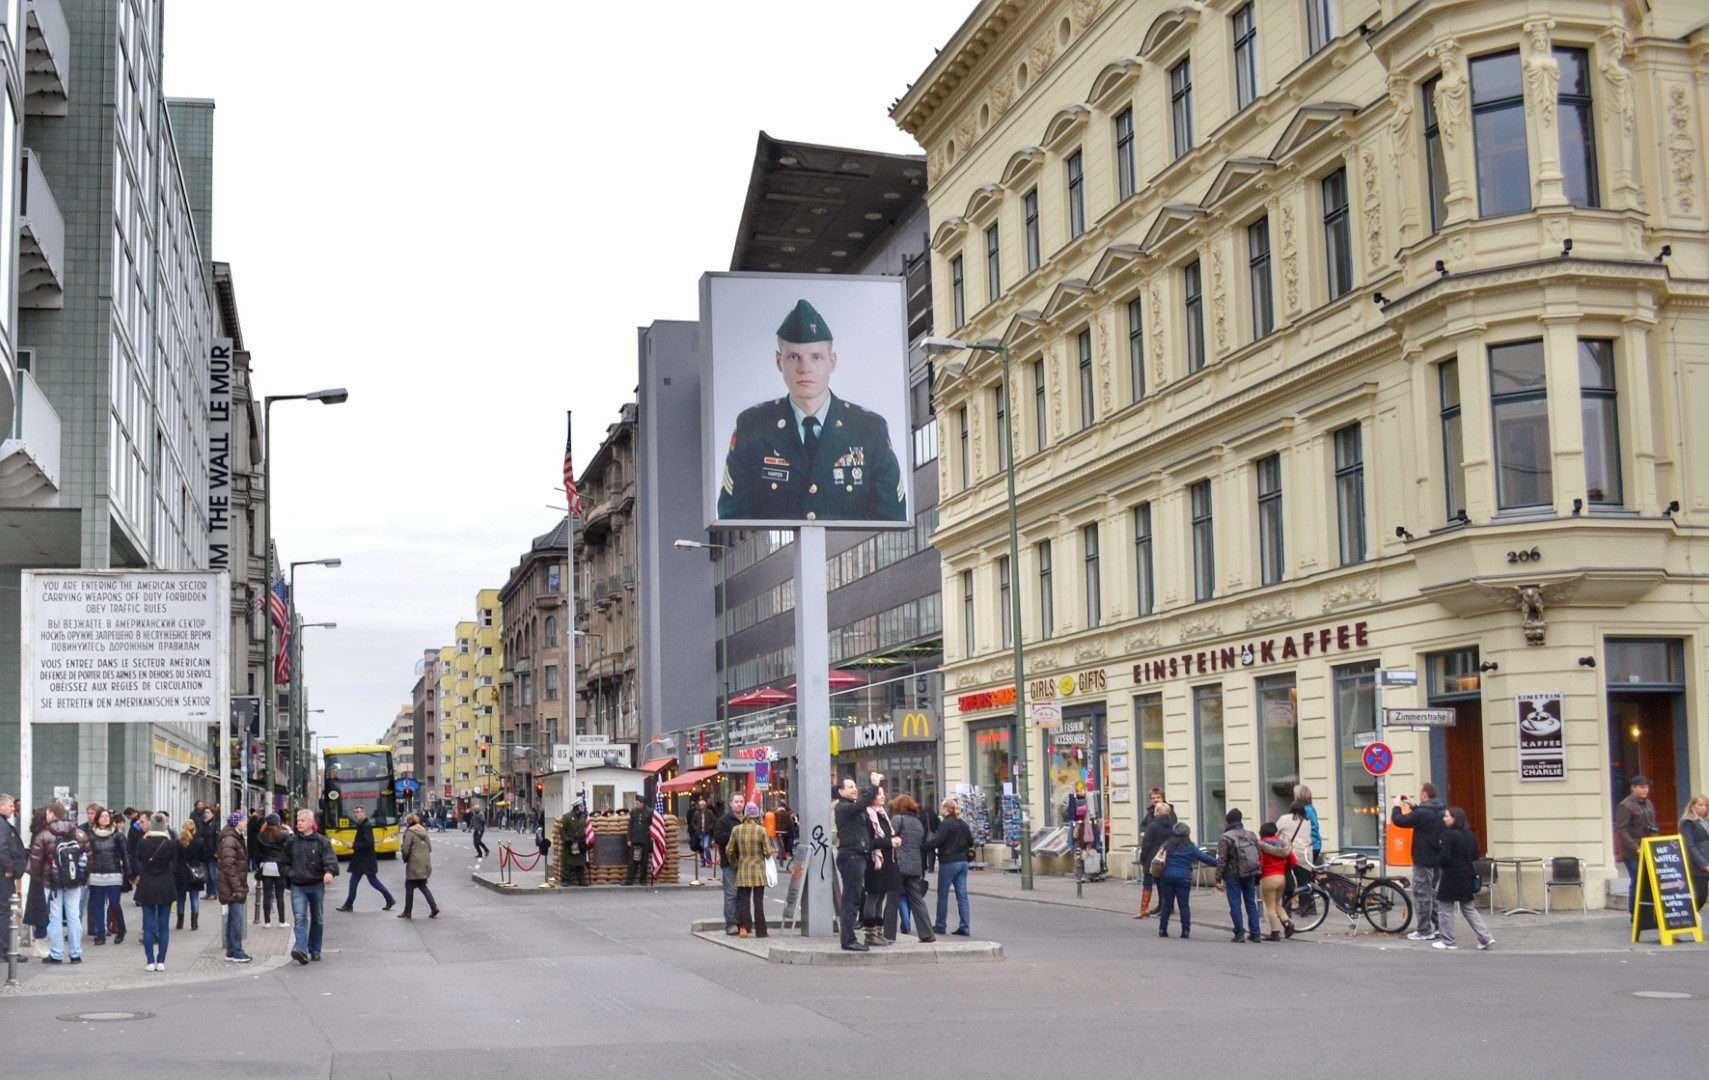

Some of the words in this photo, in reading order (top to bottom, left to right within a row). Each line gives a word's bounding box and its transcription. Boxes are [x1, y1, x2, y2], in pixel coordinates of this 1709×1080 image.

[210, 345, 230, 394] MUR
[210, 401, 229, 422] LE
[209, 433, 229, 489] WALL
[209, 495, 229, 533] THE
[209, 544, 228, 569] M
[1507, 546, 1541, 563] 206
[43, 581, 59, 591] YOU
[62, 581, 78, 591] ARE
[81, 581, 117, 591] ENTERING
[120, 581, 133, 590] THE
[137, 581, 175, 590] AMERICAN
[179, 581, 207, 590] SECTOR
[42, 592, 82, 602] CARRYING
[85, 592, 122, 602] WEAPONS
[125, 592, 139, 602] OFF
[143, 592, 162, 602] DUTY
[165, 592, 207, 602] FORBIDDEN
[86, 604, 106, 614] OBEY
[110, 604, 140, 613] TRAFFIC
[144, 603, 167, 613] RULES
[48, 619, 60, 629] ВЫ
[106, 619, 112, 628] В
[178, 619, 205, 628] СЕКТОР
[40, 631, 65, 640] НОСИТЬ
[67, 631, 94, 640] ОРУЖИЕ
[136, 631, 141, 640] В
[190, 630, 211, 640] ВРЕМЯ
[109, 642, 154, 651] ДОРОЖНЫМ
[158, 641, 200, 651] ПРАВИЛАМ
[1133, 646, 1235, 684] EINSTEIN
[1260, 621, 1368, 664] KAFFEE
[40, 659, 62, 668] VOUS
[66, 659, 93, 668] ENTREZ
[97, 659, 118, 668] DANS
[121, 659, 129, 668] LE
[132, 658, 166, 668] SECTEUR
[68, 671, 77, 680] DE
[77, 671, 101, 680] PORTER
[102, 671, 115, 680] DES
[115, 670, 137, 680] ARMES
[138, 670, 147, 679] EN
[148, 670, 174, 679] DEHORS
[175, 670, 185, 679] DU
[186, 670, 212, 679] SERVICE
[91, 682, 107, 691] AUX
[142, 681, 151, 690] DE
[155, 681, 203, 690] CIRCULATION
[1030, 678, 1055, 699] GIRLS
[1079, 669, 1106, 691] GIFTS
[40, 698, 52, 708] SIE
[56, 698, 93, 709] BETRETEN
[96, 697, 111, 708] DEN
[114, 697, 179, 707] AMERIKANISCHEN
[182, 696, 211, 707] SEKTOR
[1395, 711, 1447, 723] Zimmerstraße
[1065, 721, 1084, 732] FASHION
[557, 749, 567, 758] US
